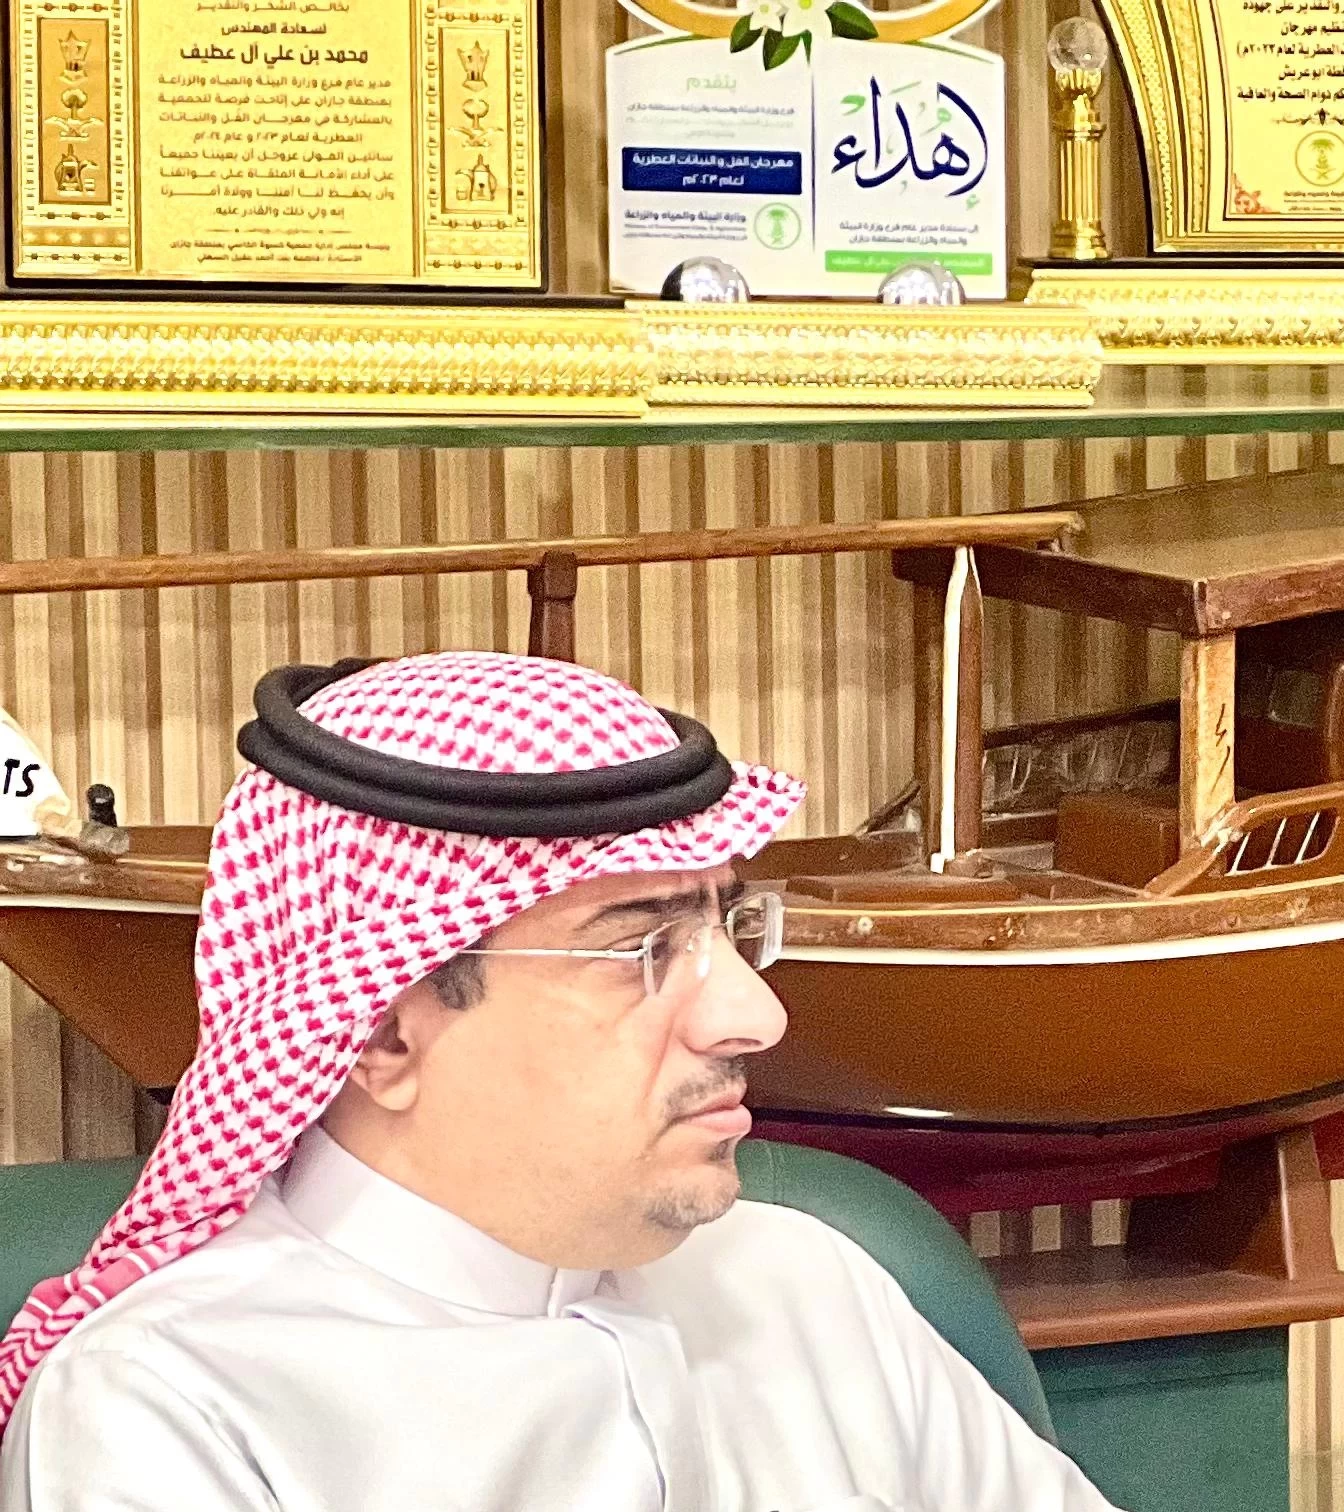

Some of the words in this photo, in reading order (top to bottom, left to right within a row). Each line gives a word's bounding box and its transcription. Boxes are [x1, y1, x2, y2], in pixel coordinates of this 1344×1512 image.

[221, 22, 277, 36] المهندس
[1280, 21, 1318, 37] مهرجان
[180, 43, 236, 64] عطيف
[264, 44, 295, 70] علي
[300, 44, 319, 66] بن
[324, 49, 368, 64] محمد
[719, 175, 745, 187] لعام
